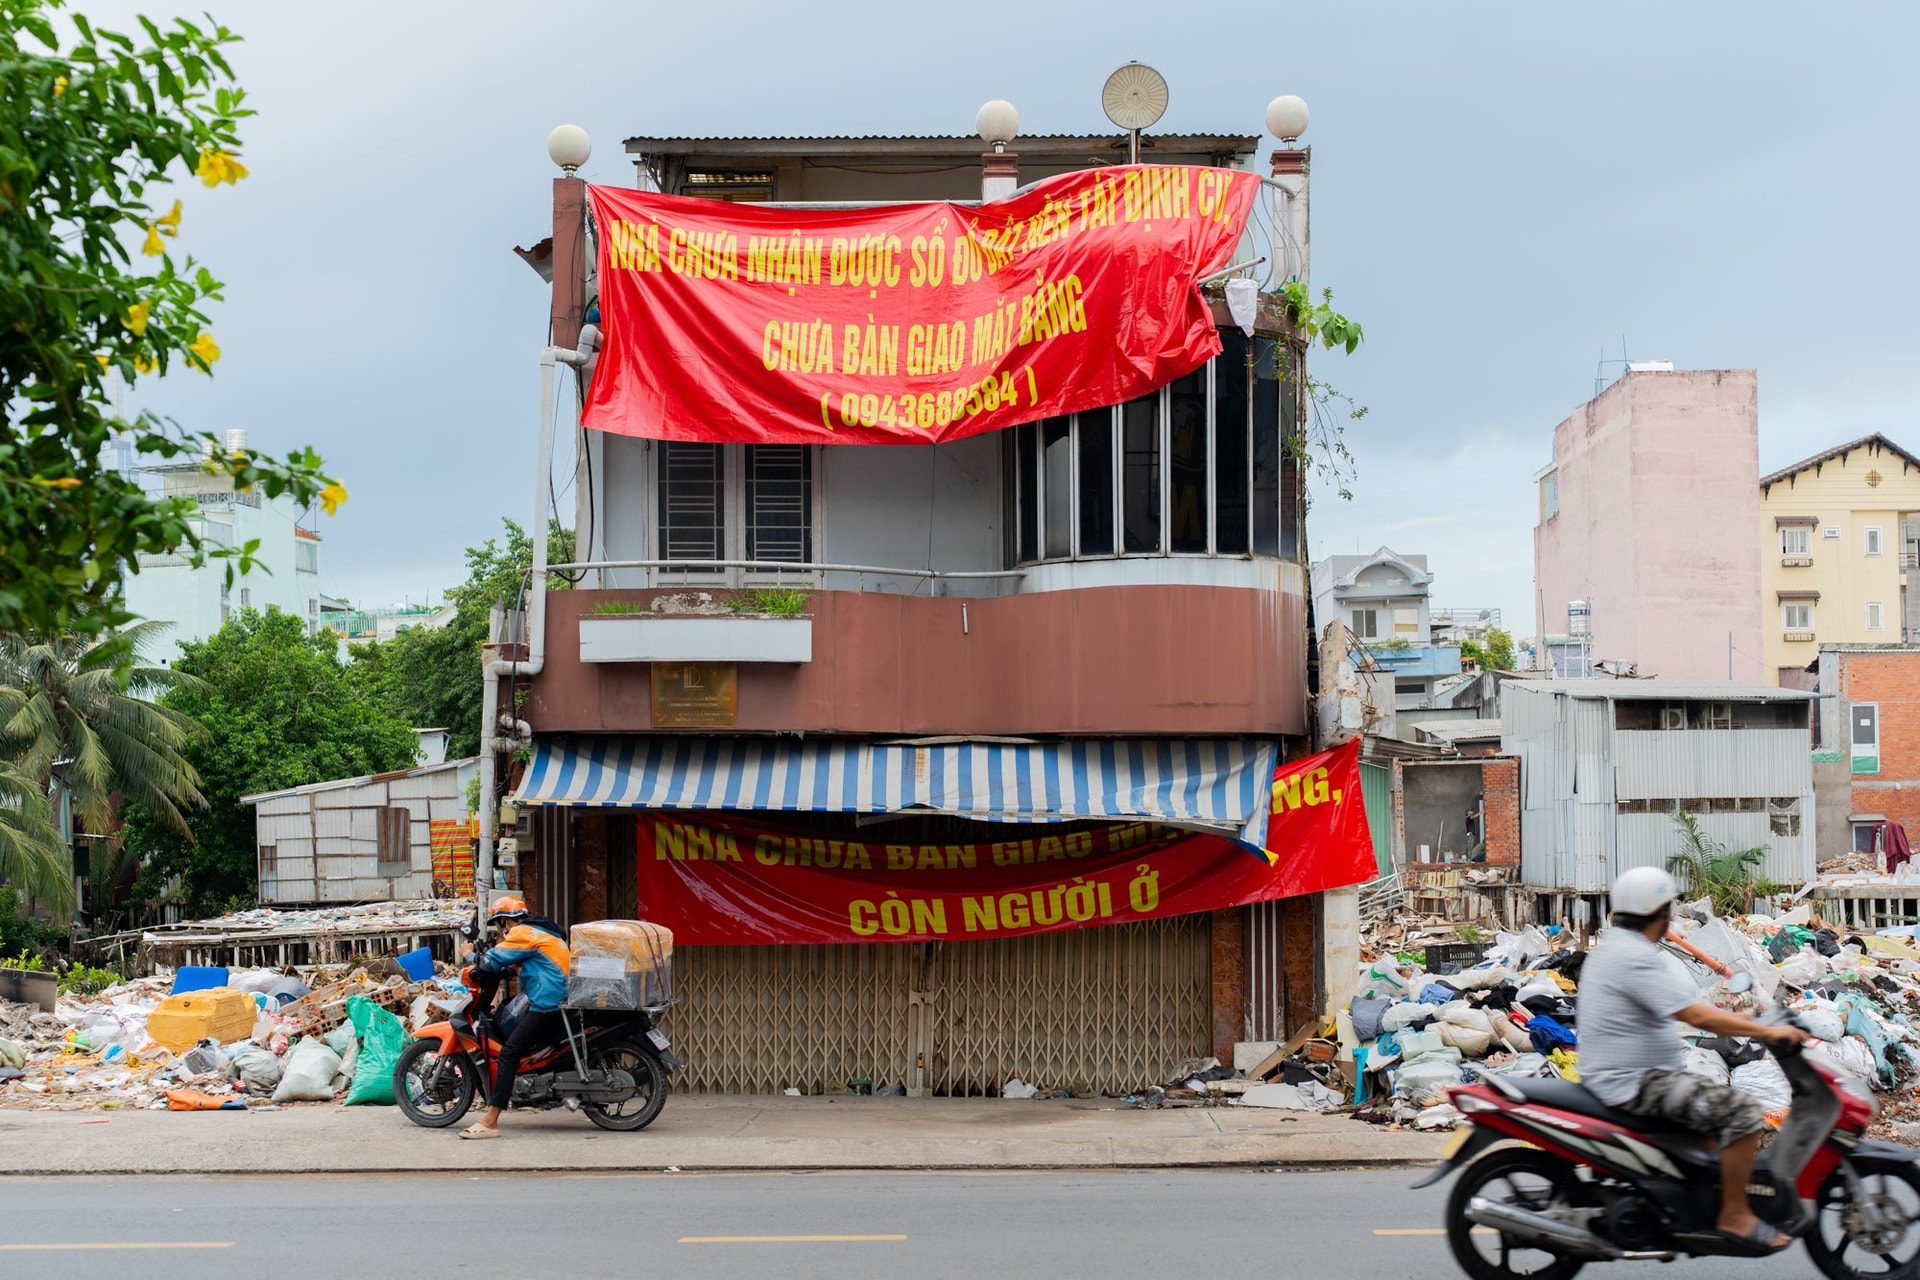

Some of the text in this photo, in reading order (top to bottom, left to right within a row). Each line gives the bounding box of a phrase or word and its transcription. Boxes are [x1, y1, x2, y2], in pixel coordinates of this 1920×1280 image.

[611, 215, 662, 272] NHÀ
[668, 228, 738, 281] CHƯA
[747, 228, 824, 296] NHẬN
[830, 232, 901, 299] ĐƯỢC
[909, 217, 948, 287] SỔ
[951, 216, 983, 285] ĐỎ
[1124, 167, 1190, 232] ĐỊNH
[762, 267, 1088, 376] CHƯA BÀN GIAO MẶT BẰNG
[655, 821, 744, 862] NHÀ
[991, 831, 1093, 866] GIAO
[848, 863, 1160, 936] CÒN NGƯỜI Ở
